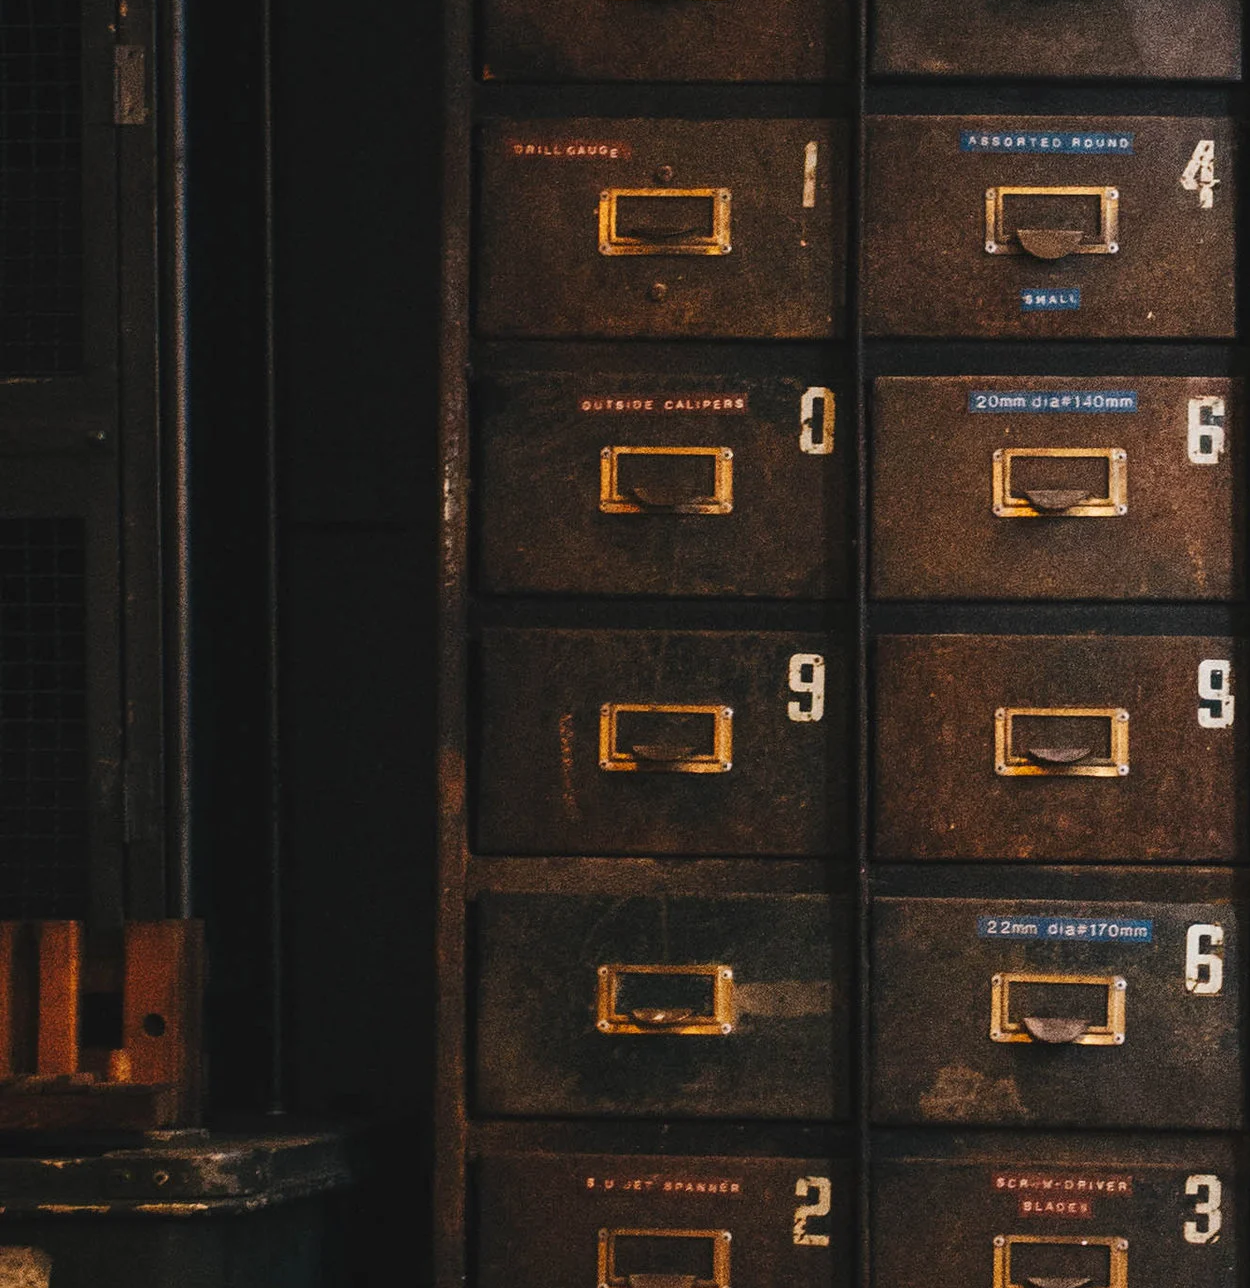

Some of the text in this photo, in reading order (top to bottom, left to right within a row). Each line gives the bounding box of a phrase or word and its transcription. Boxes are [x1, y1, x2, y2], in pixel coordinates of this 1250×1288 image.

[513, 144, 619, 159] DRILL GAUGE
[967, 136, 1130, 149] ASSORTED ROUND
[1180, 140, 1219, 208] 4
[1022, 293, 1078, 306] SMALL
[581, 398, 745, 411] OUTSIDE CALIPERS
[800, 387, 834, 454] 0
[975, 395, 1134, 409] 20mm dia#140mm
[1188, 396, 1224, 464] 6
[788, 654, 824, 721] 9
[1198, 659, 1234, 728] 9
[986, 920, 1148, 938] 22mm dia#170mm
[1186, 925, 1223, 994] 6
[663, 1182, 740, 1193] SPANNER
[995, 1178, 1127, 1192] SCRW-DRIVER
[794, 1177, 830, 1246] 2
[1184, 1175, 1221, 1243] 3
